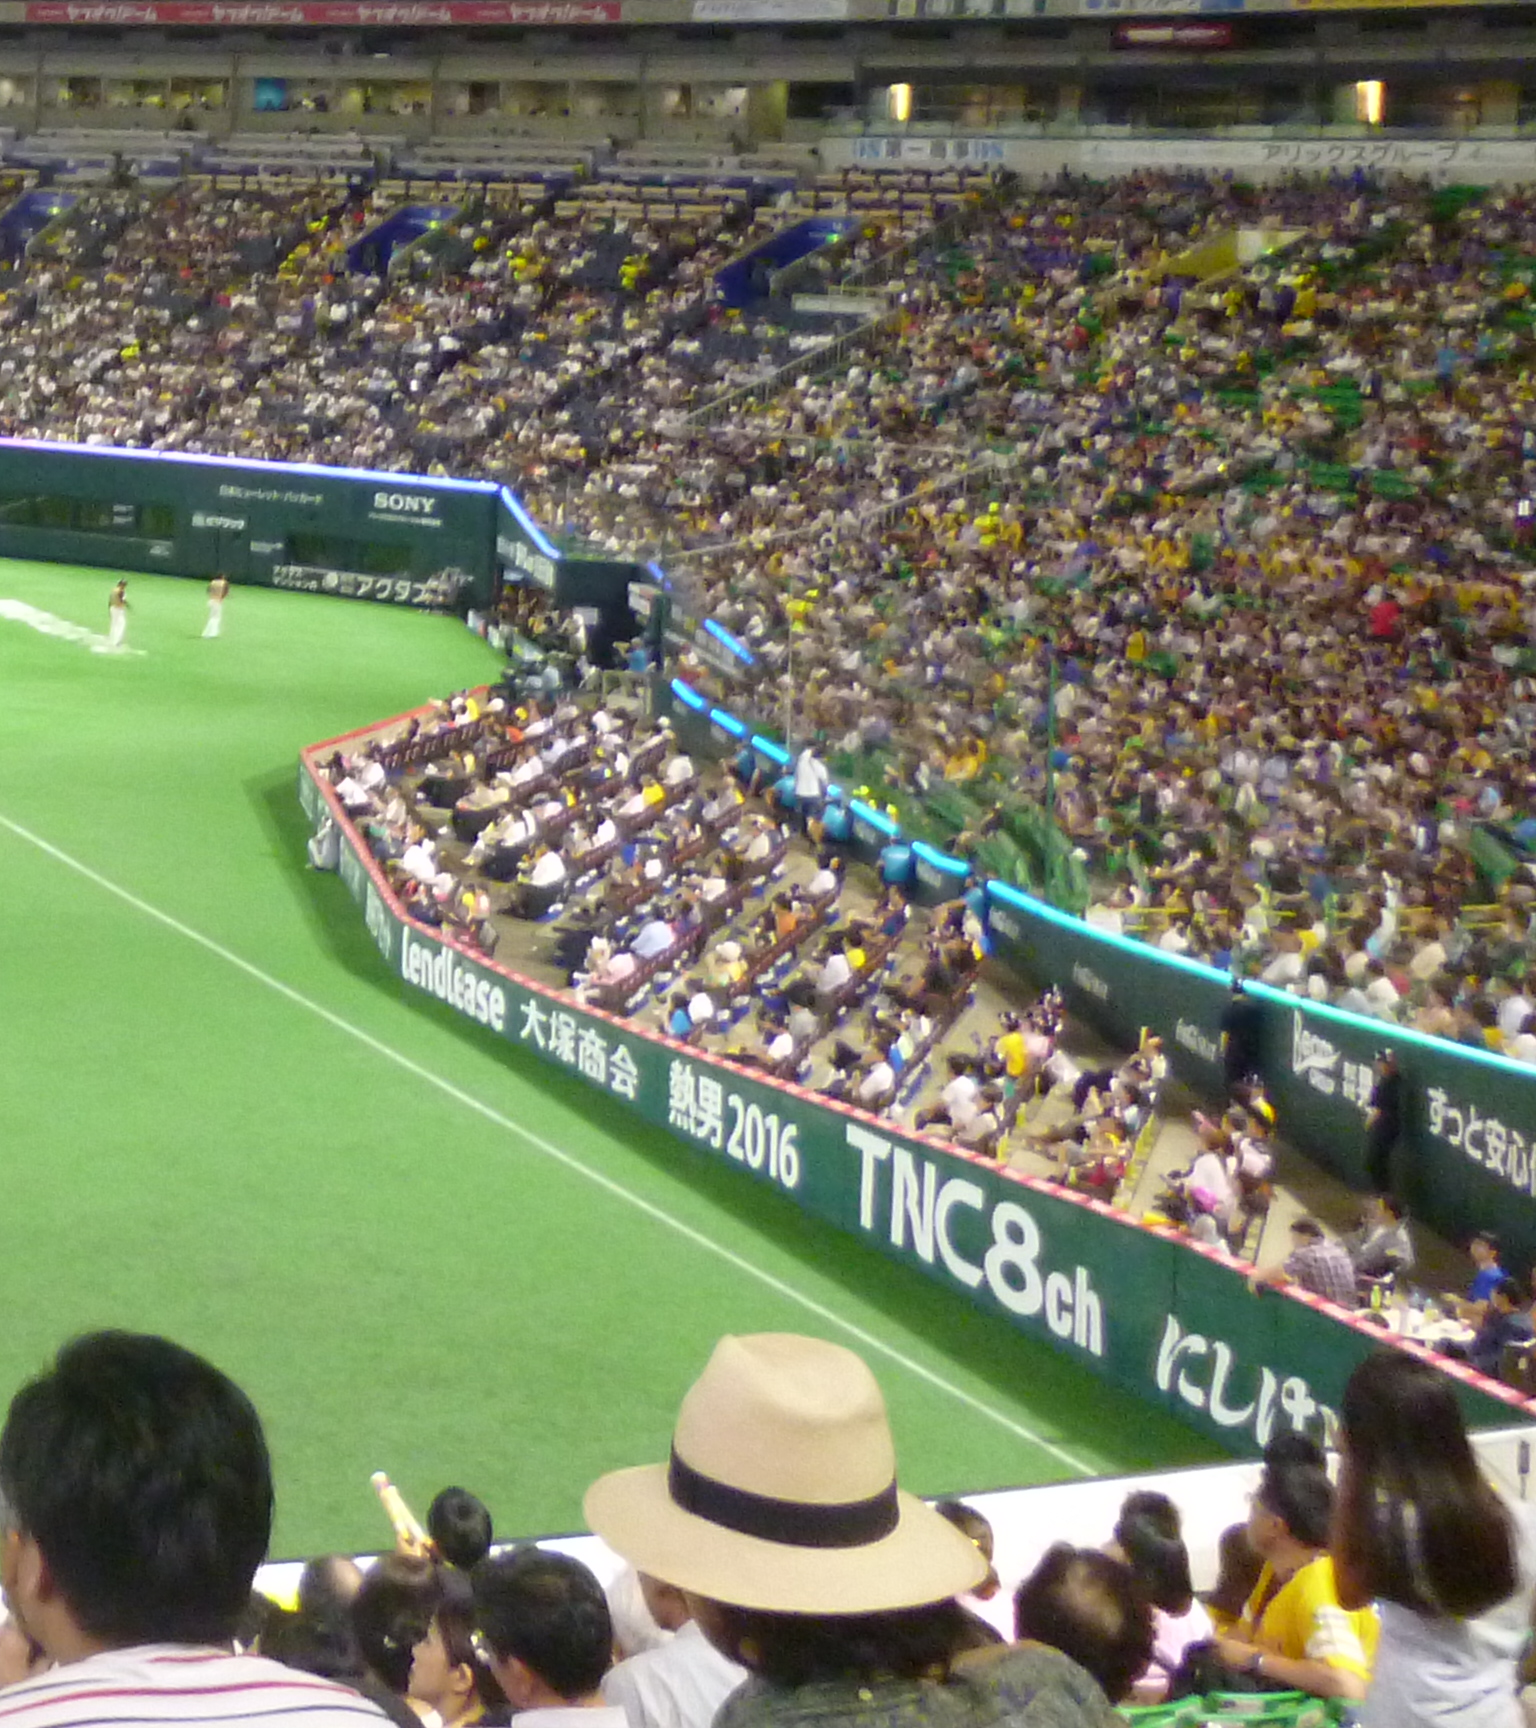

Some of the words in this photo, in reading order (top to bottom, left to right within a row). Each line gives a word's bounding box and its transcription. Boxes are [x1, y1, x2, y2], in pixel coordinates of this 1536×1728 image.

[373, 492, 436, 513] SONY
[520, 999, 639, 1100] 大塚商会
[1427, 1086, 1536, 1198] ずっと安心
